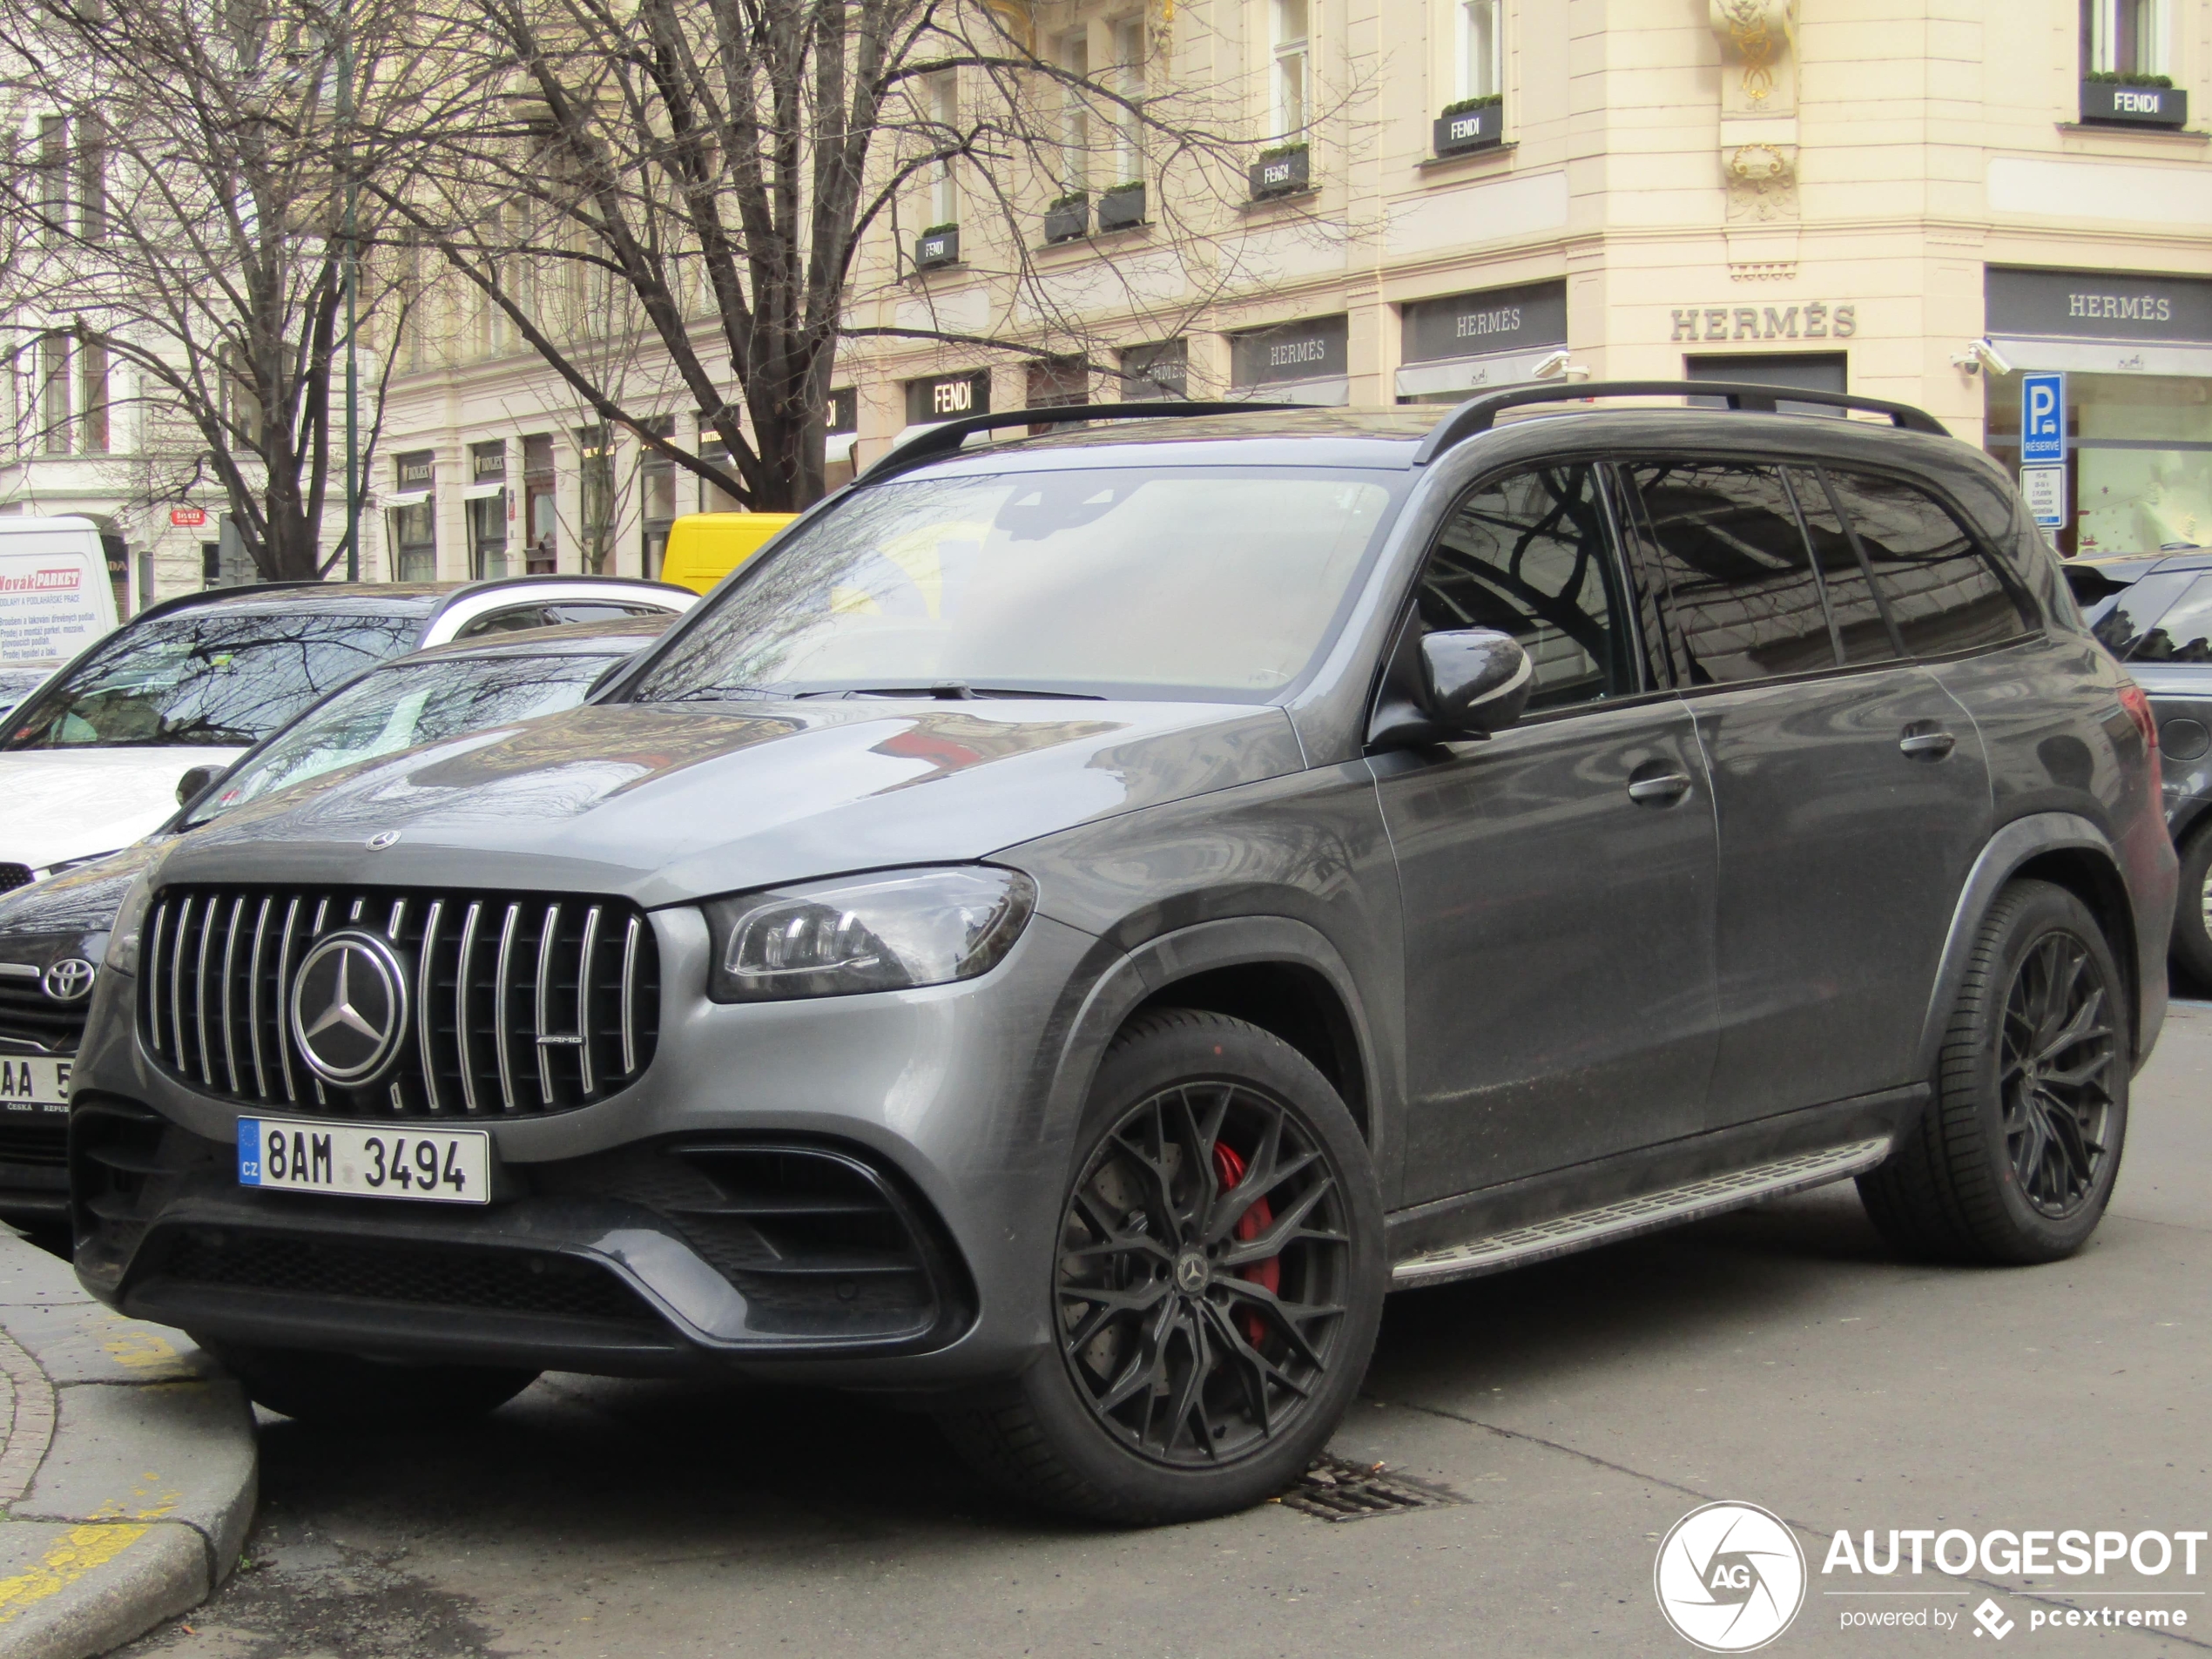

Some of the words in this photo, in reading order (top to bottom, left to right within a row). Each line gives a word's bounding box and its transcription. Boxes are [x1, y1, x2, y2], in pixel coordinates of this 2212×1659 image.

[2114, 92, 2158, 113] FENDI
[1451, 118, 1480, 140] FENDI
[1264, 164, 1290, 185] FENDI
[926, 240, 944, 257] FENDI
[934, 381, 972, 414] FENDI
[2031, 386, 2054, 435] P
[2025, 438, 2060, 452] RÉSERVÉ
[8, 1103, 33, 1111] ČESKÁ
[44, 1104, 70, 1113] REPUB
[242, 1162, 259, 1177] CZ
[268, 1130, 333, 1184] 8AM
[364, 1136, 466, 1192] 3494
